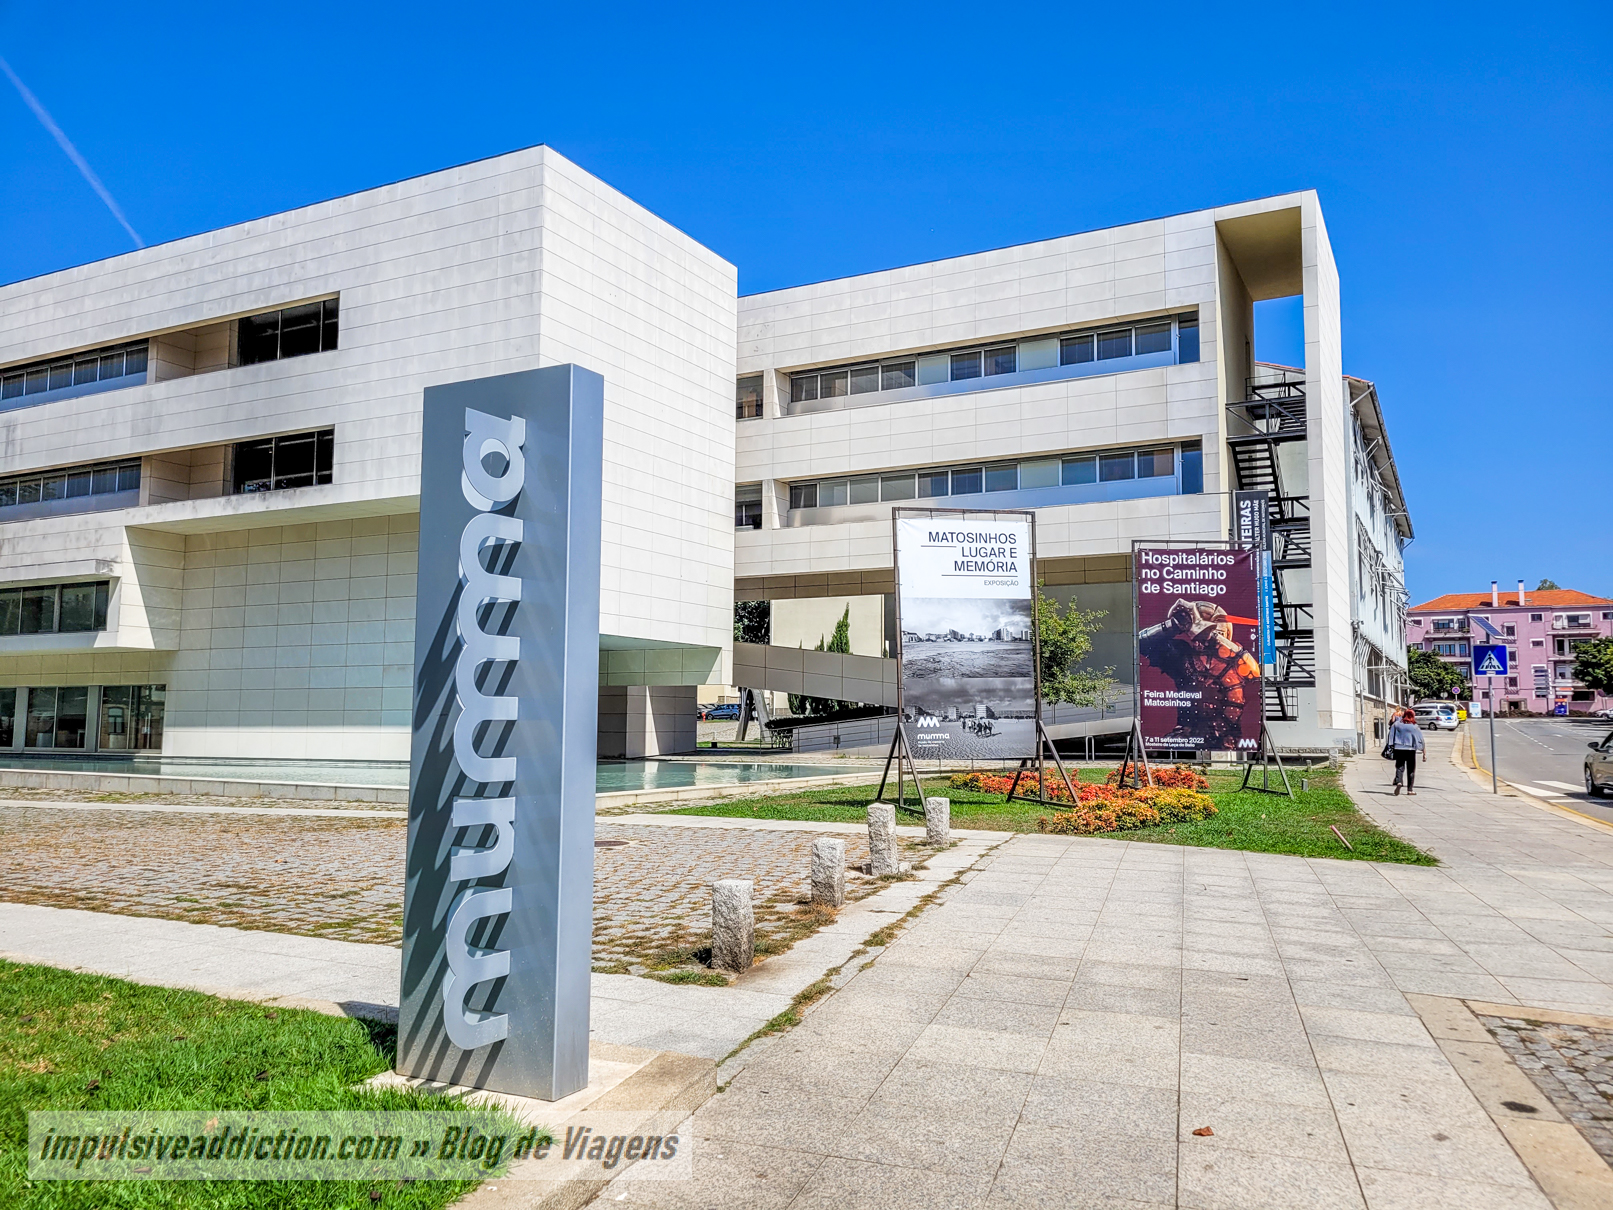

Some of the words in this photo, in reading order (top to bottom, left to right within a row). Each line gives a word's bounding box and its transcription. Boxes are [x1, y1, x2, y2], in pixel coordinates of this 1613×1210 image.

[928, 531, 1017, 544] MATOSINHOS
[961, 546, 1006, 558] LUGAR
[1009, 547, 1018, 559] E
[1141, 552, 1235, 566] Hospitalários
[954, 559, 1018, 573] MEMÓRIA
[1142, 568, 1159, 578] no
[1163, 567, 1227, 580] Caminho
[983, 579, 1019, 587] EXPOSIÇÃO
[1142, 581, 1160, 593] de
[1163, 581, 1226, 597] Santiago
[1144, 690, 1164, 698] Feira
[1165, 690, 1202, 699] Medieval
[1144, 699, 1192, 707] Matosinhos
[443, 407, 526, 1050] mumma
